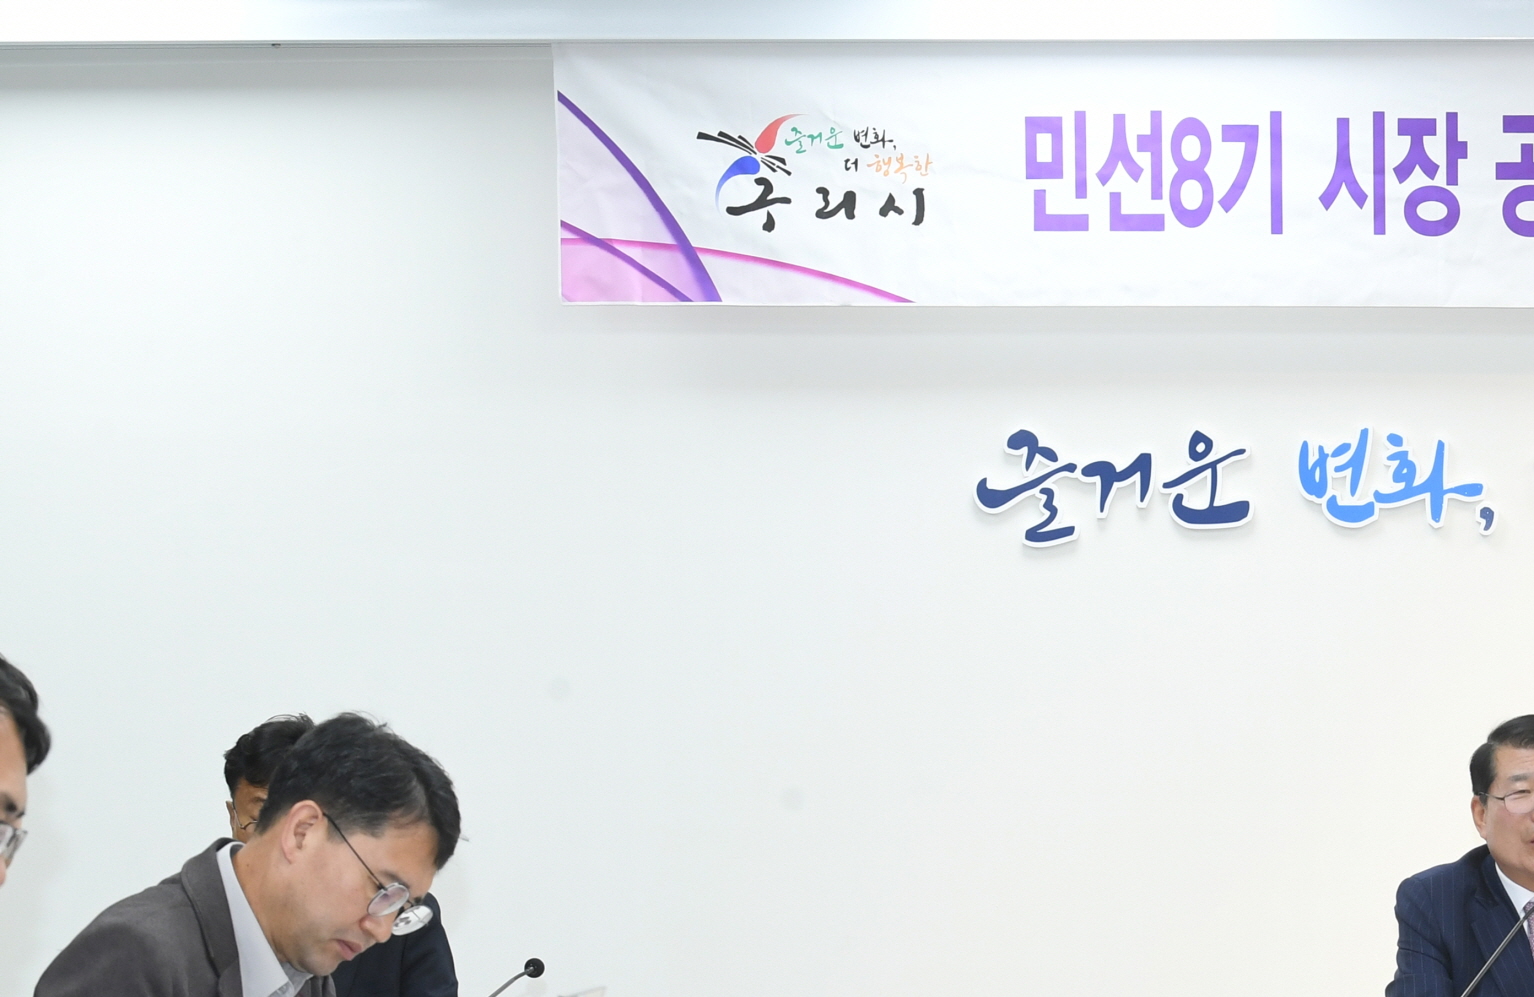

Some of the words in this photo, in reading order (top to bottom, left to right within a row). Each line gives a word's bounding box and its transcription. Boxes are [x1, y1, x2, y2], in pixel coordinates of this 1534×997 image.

[784, 126, 845, 154] 즐거운
[853, 126, 897, 151] 변화,
[843, 157, 860, 173] 더
[866, 153, 934, 184] 행복한
[1024, 110, 1284, 235] 민선8기
[1318, 110, 1468, 238] 시장
[975, 428, 1252, 544] 즐거운
[1297, 427, 1496, 532] 변화,
